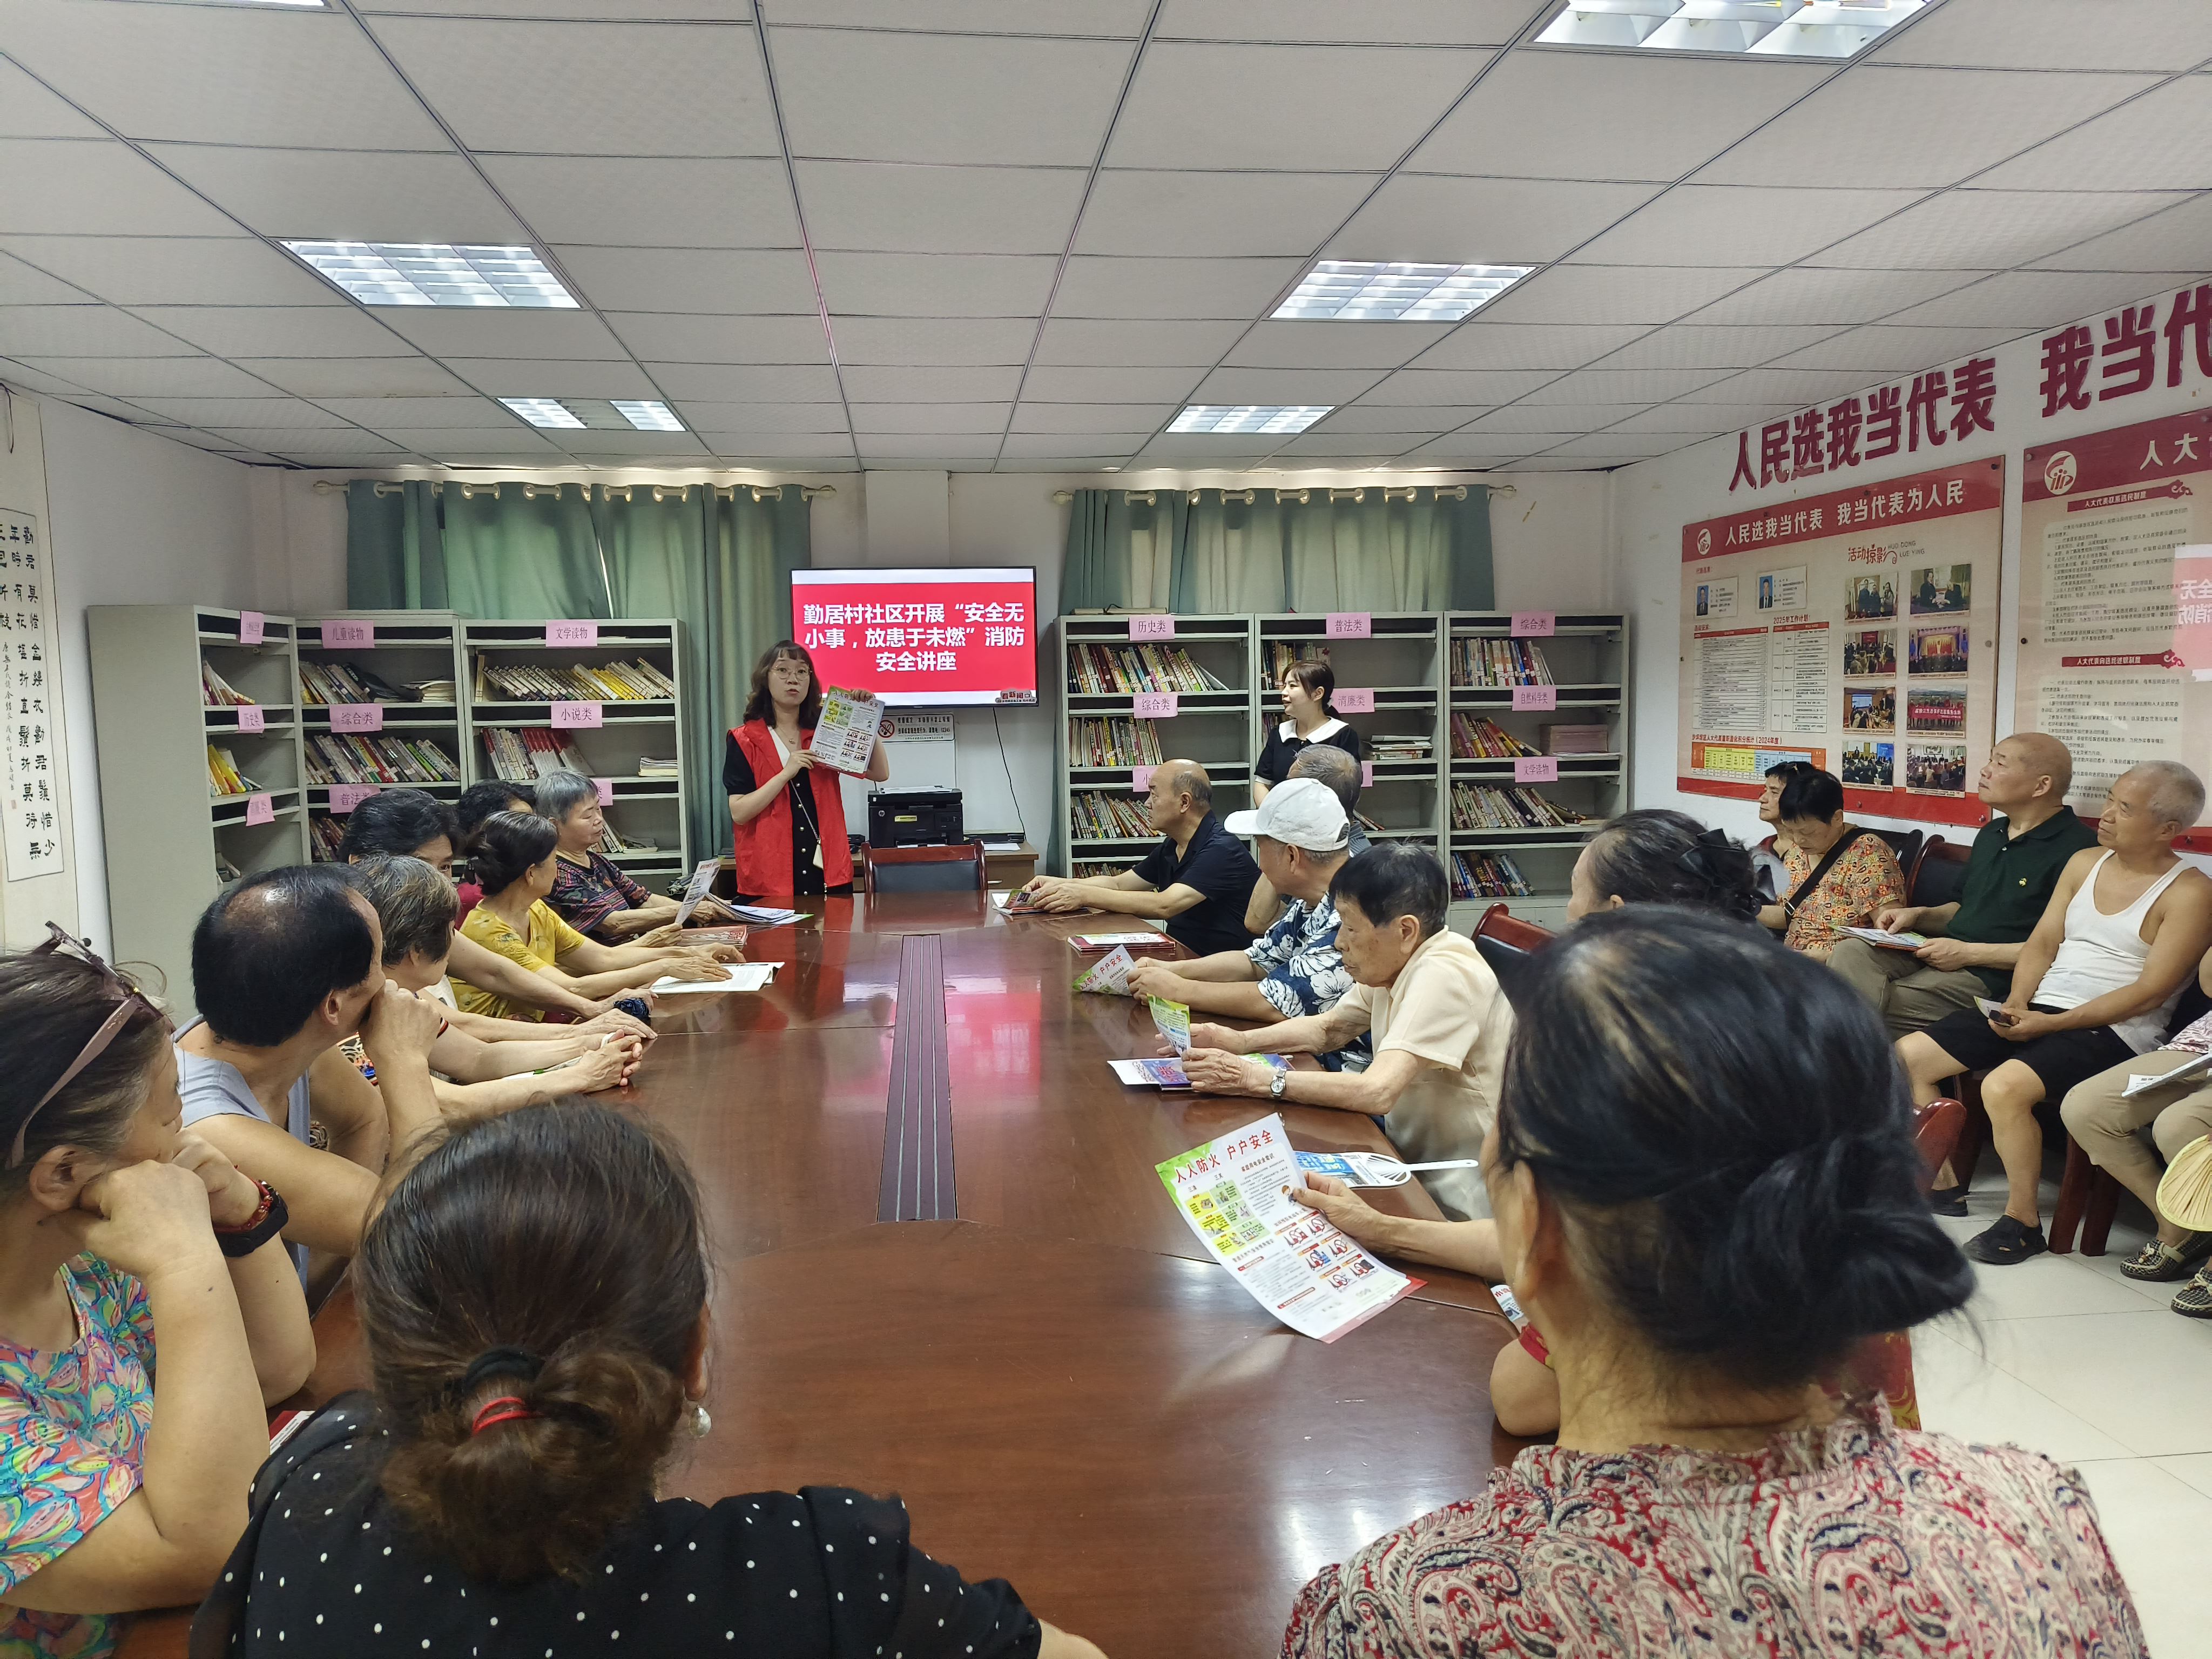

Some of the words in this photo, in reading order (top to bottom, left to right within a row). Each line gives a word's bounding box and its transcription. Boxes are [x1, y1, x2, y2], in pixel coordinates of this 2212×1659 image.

[2039, 283, 2212, 418] 我当代
[1729, 357, 1997, 493] 人民选我当代表
[2140, 433, 2212, 471] 人大
[1725, 508, 1823, 546] 人民选我当代表
[1837, 480, 1964, 527] 我当代表为人民
[1848, 544, 1887, 564] 活动掠影
[1137, 621, 1166, 633] 历史类
[1334, 618, 1363, 632] 普法类
[1520, 618, 1547, 630] 综合类
[332, 626, 364, 641] 儿童读物
[555, 626, 588, 640] 文学读物
[876, 651, 957, 672] 安全讲座
[1141, 698, 1171, 711] 综合类
[1521, 692, 1548, 704] 自然科学类
[341, 712, 374, 726] 综合类
[561, 707, 592, 721] 小说类
[1523, 763, 1550, 776] 文学读物
[1175, 1153, 1220, 1183] 人人防火
[1226, 1129, 1273, 1160] 户户安全
